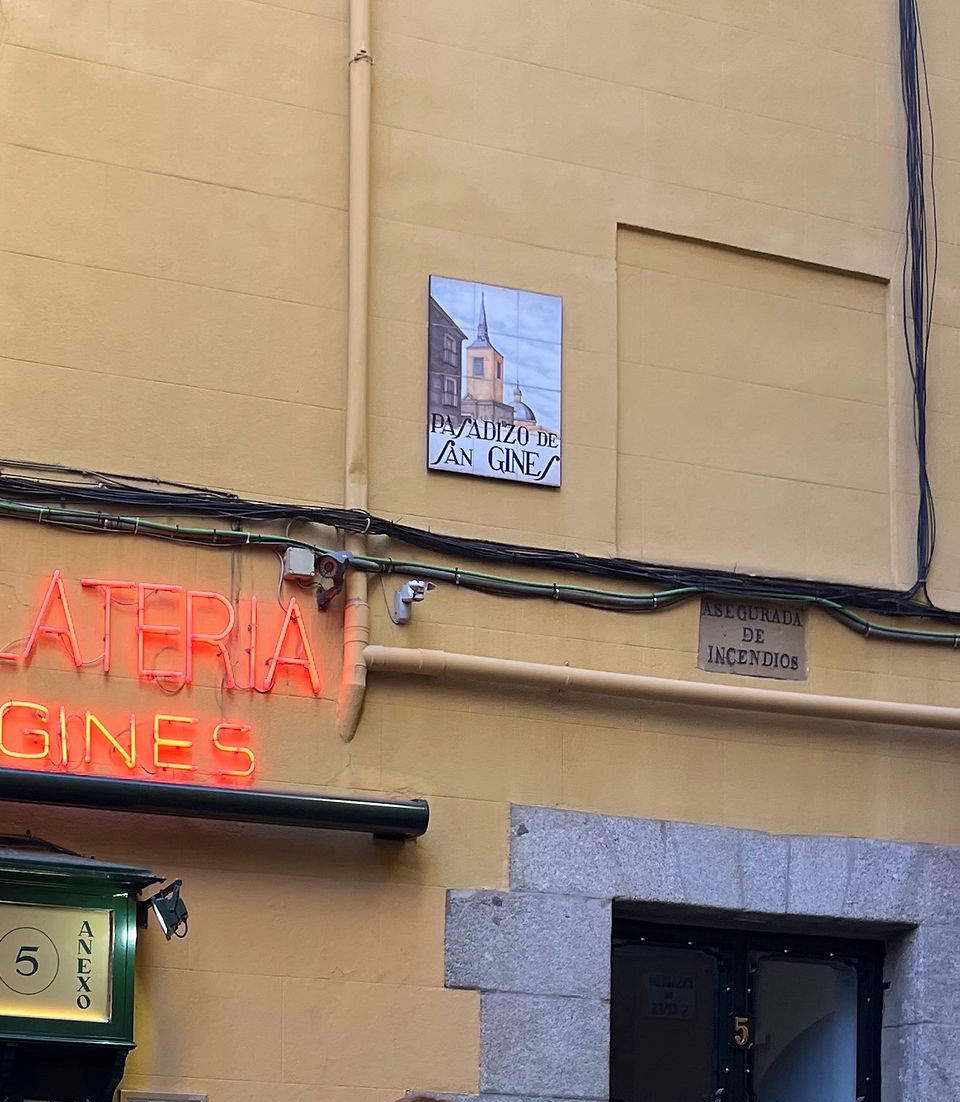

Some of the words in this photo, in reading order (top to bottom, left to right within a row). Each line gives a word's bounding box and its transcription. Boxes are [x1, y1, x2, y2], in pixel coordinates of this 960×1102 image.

[431, 413, 529, 446] PASADIZO
[536, 431, 559, 448] DE
[431, 440, 473, 467] SAN
[488, 446, 560, 481] GINES
[702, 600, 803, 627] ASEGURADA
[742, 627, 765, 644] DE
[707, 645, 799, 670] INCENDIOS
[15, 946, 39, 976] 5
[76, 920, 94, 1010] ANEXO
[734, 1016, 749, 1045] 5
